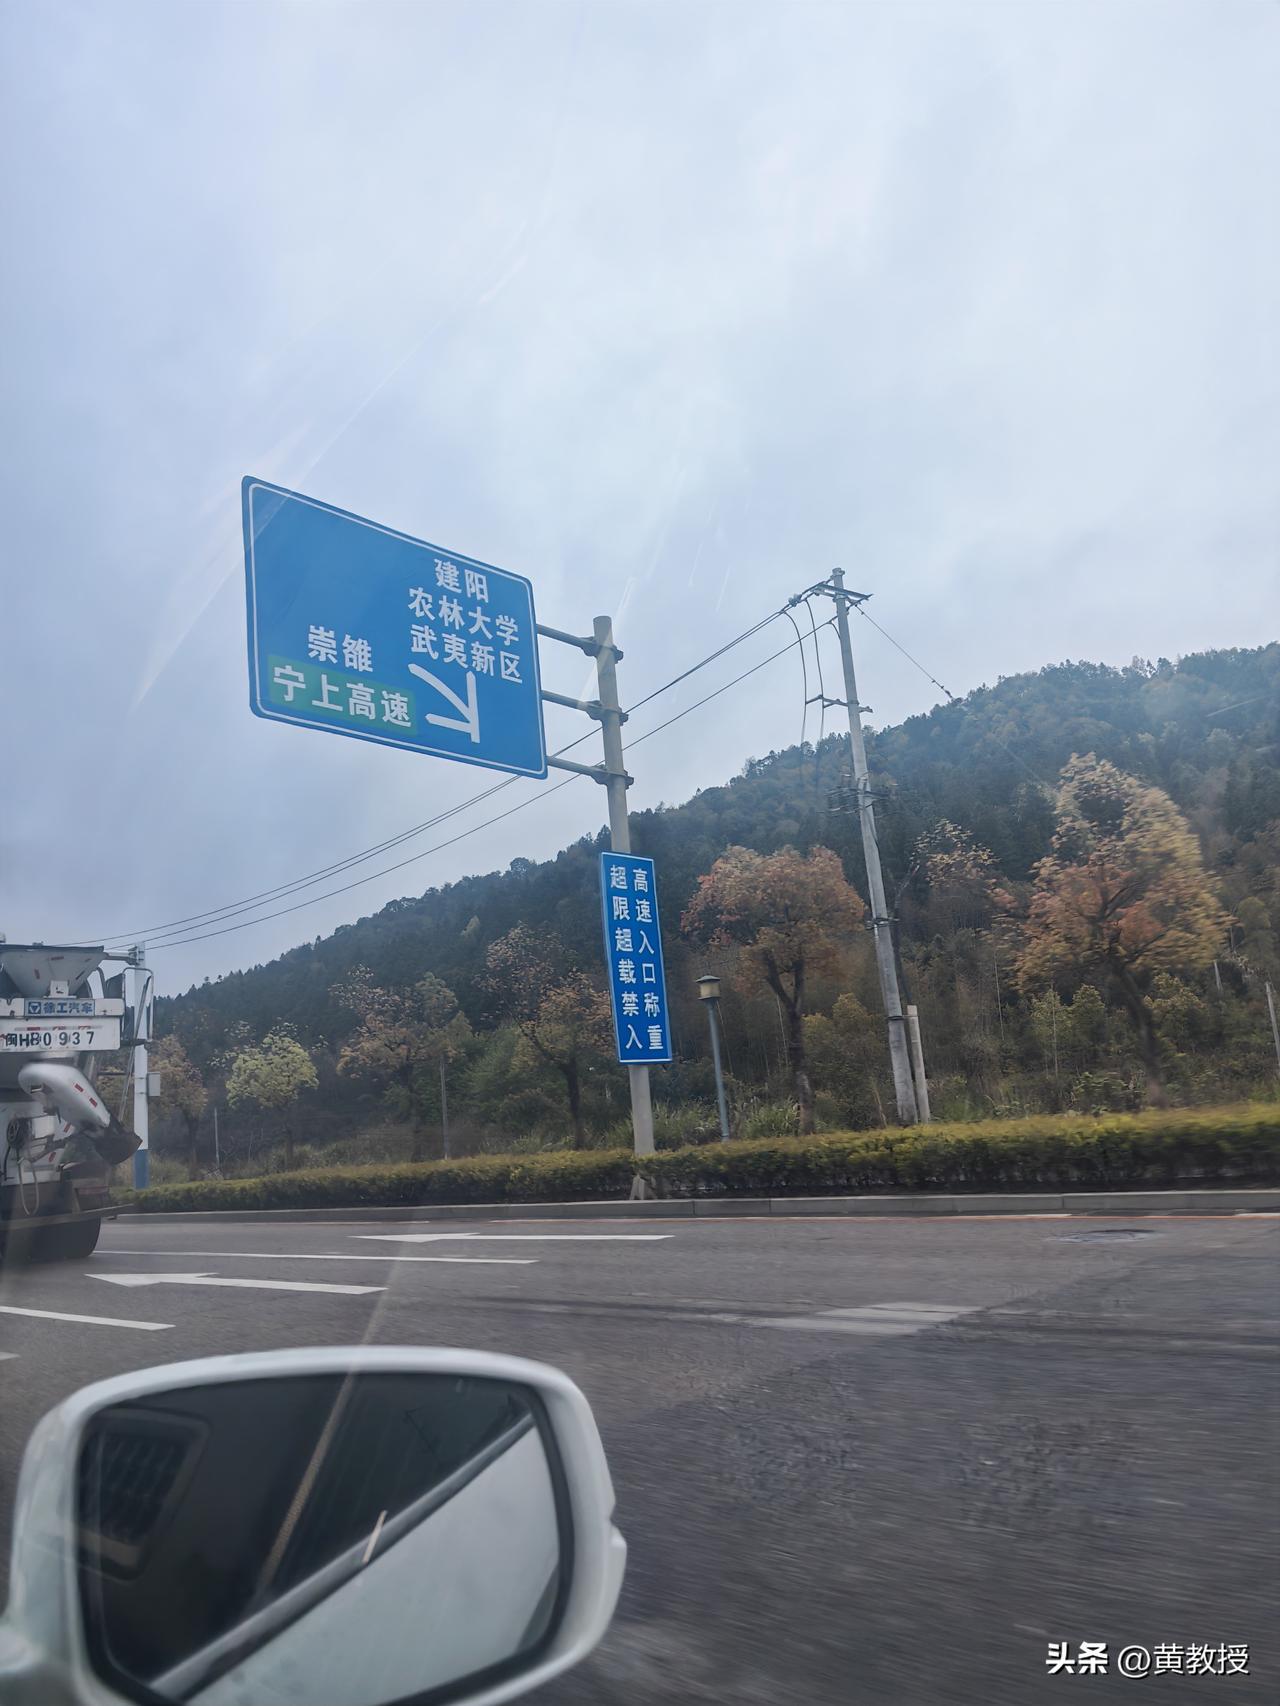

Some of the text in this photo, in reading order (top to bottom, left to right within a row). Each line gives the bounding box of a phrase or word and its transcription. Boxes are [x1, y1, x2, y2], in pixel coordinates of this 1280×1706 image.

[434, 558, 489, 603] 建阳
[408, 587, 519, 647] 农林大学
[410, 624, 523, 684] 武夷新区
[273, 665, 412, 727] 宁上高速
[610, 864, 643, 1050] 超限超载禁入
[633, 868, 664, 1051] 高速入口称重
[43, 1002, 93, 1014] 徐工汽车
